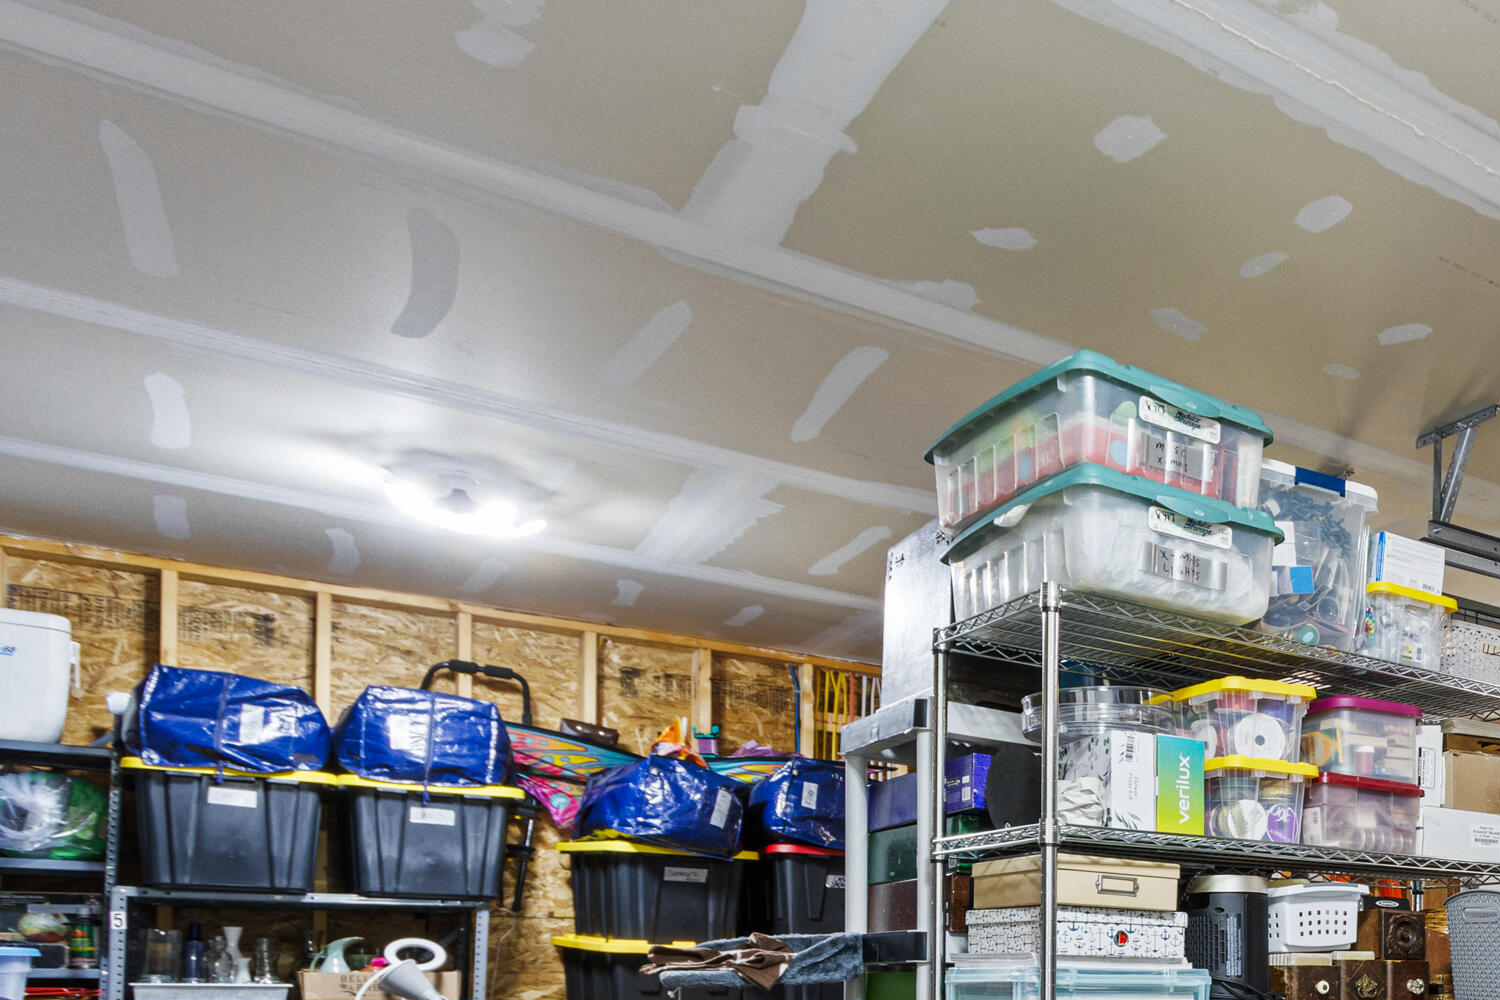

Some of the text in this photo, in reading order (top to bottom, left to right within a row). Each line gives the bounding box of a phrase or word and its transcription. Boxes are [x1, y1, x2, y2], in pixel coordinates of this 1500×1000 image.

[1174, 415, 1202, 431] Storage
[1156, 442, 1187, 457] MSC
[1184, 522, 1213, 537] Storage
[1175, 754, 1191, 824] verilux
[114, 912, 124, 928] 5
